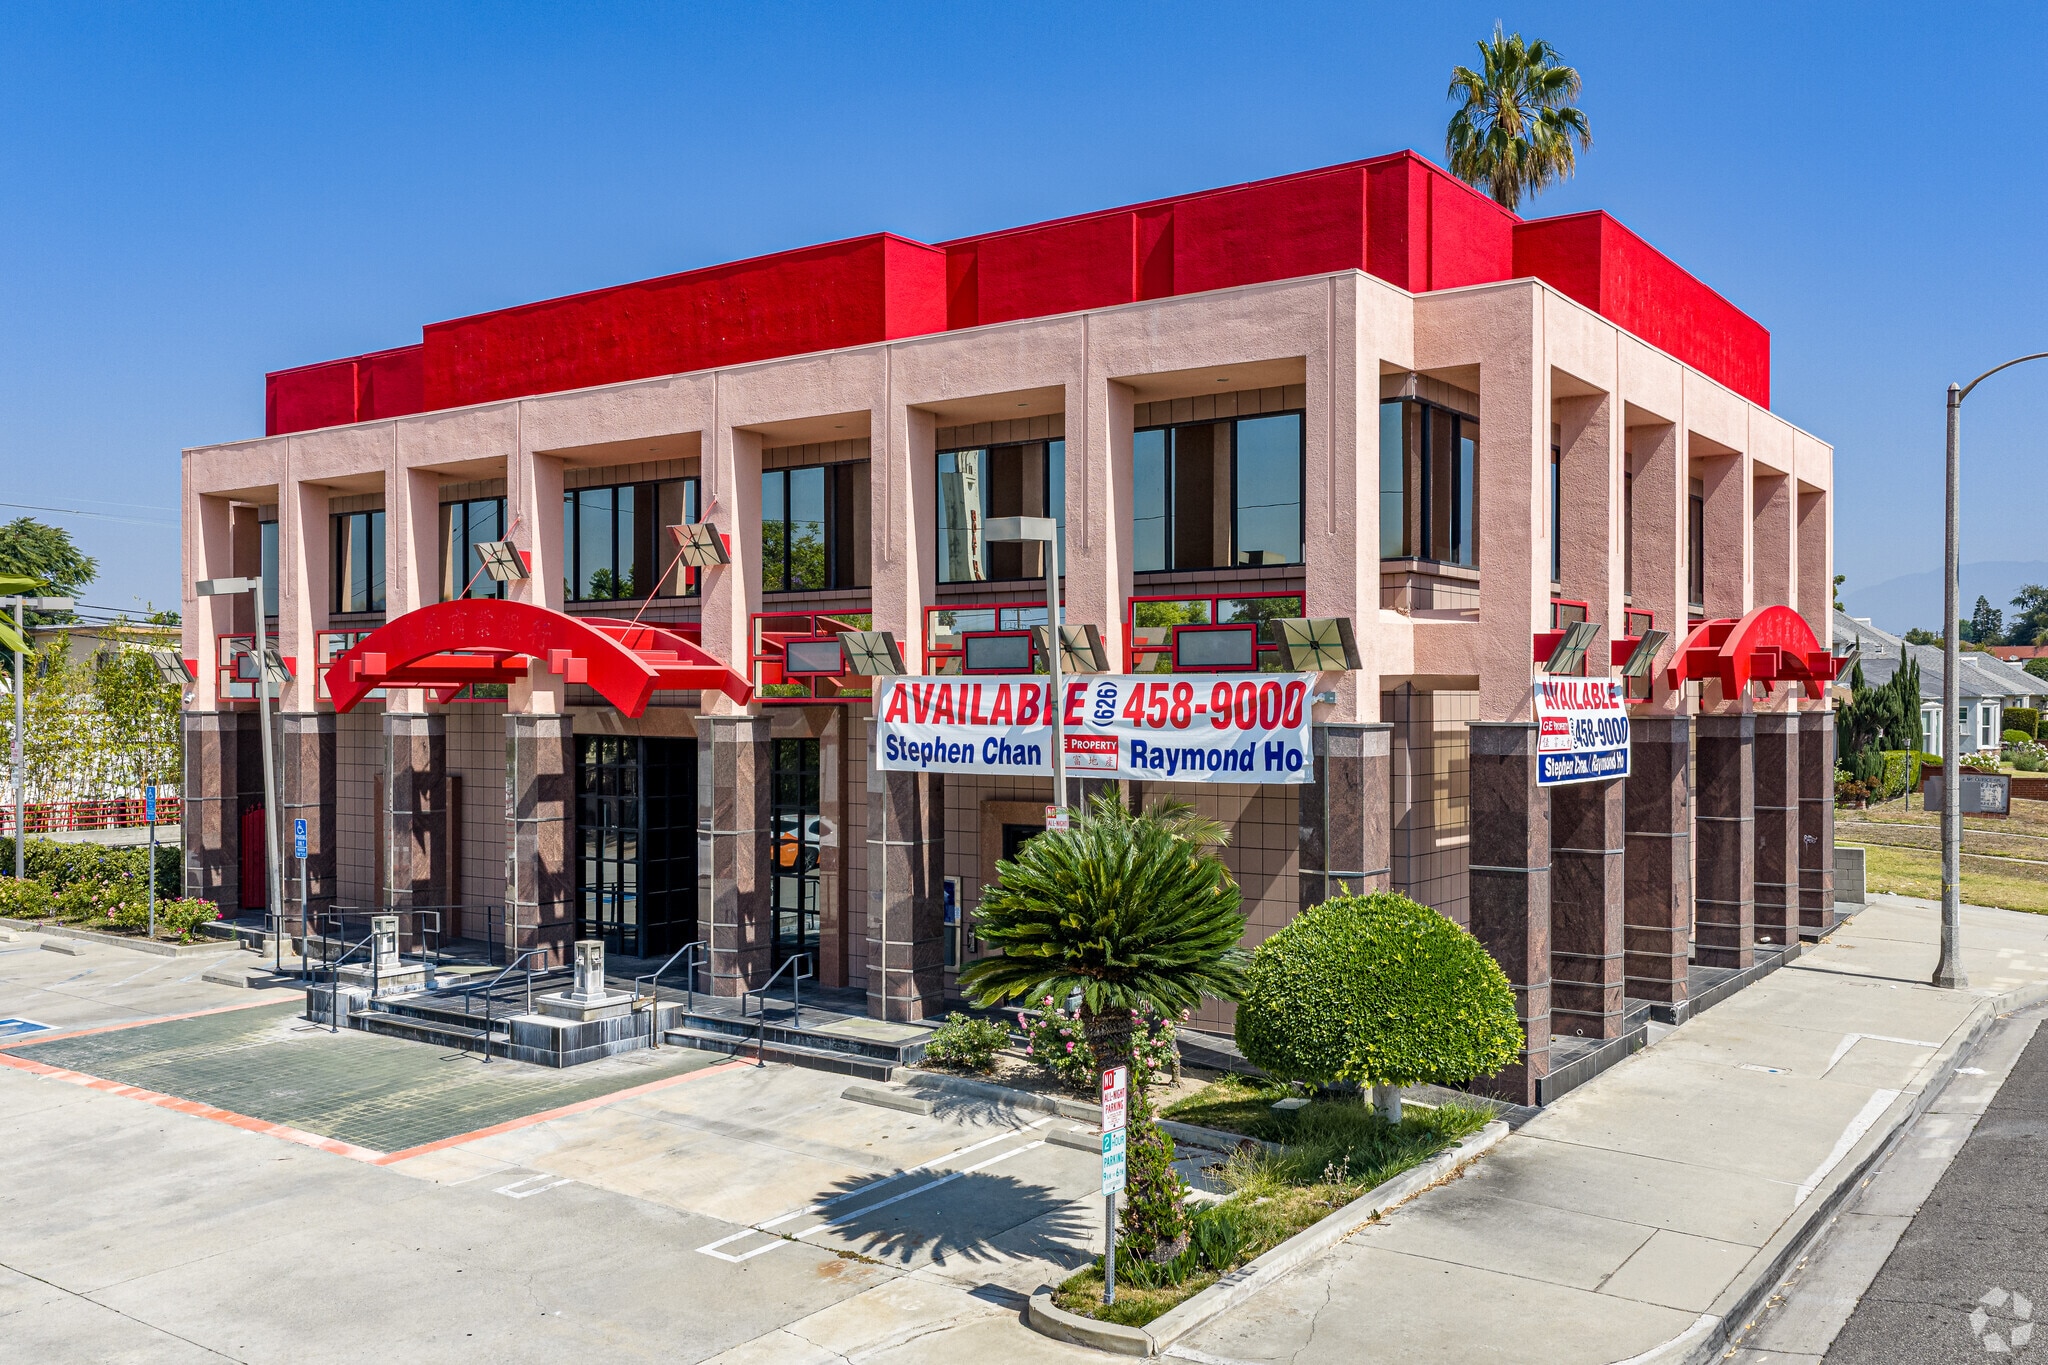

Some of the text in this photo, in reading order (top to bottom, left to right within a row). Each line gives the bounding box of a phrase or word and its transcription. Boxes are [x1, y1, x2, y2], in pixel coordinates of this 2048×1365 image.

[884, 681, 1307, 730] AVAILABLE (626) 458-9000
[1542, 681, 1620, 710] AVAILABLE
[1575, 716, 1629, 748] 458-9000
[886, 733, 1042, 768] Stephen Chan
[1071, 739, 1117, 750] PROPERTY
[1130, 739, 1303, 777] Raymond Ho
[1104, 1073, 1113, 1088] NO
[1105, 1100, 1124, 1114] PARKING
[1104, 1135, 1125, 1150] 2 HOUR
[1104, 1152, 1124, 1168] PARKING
